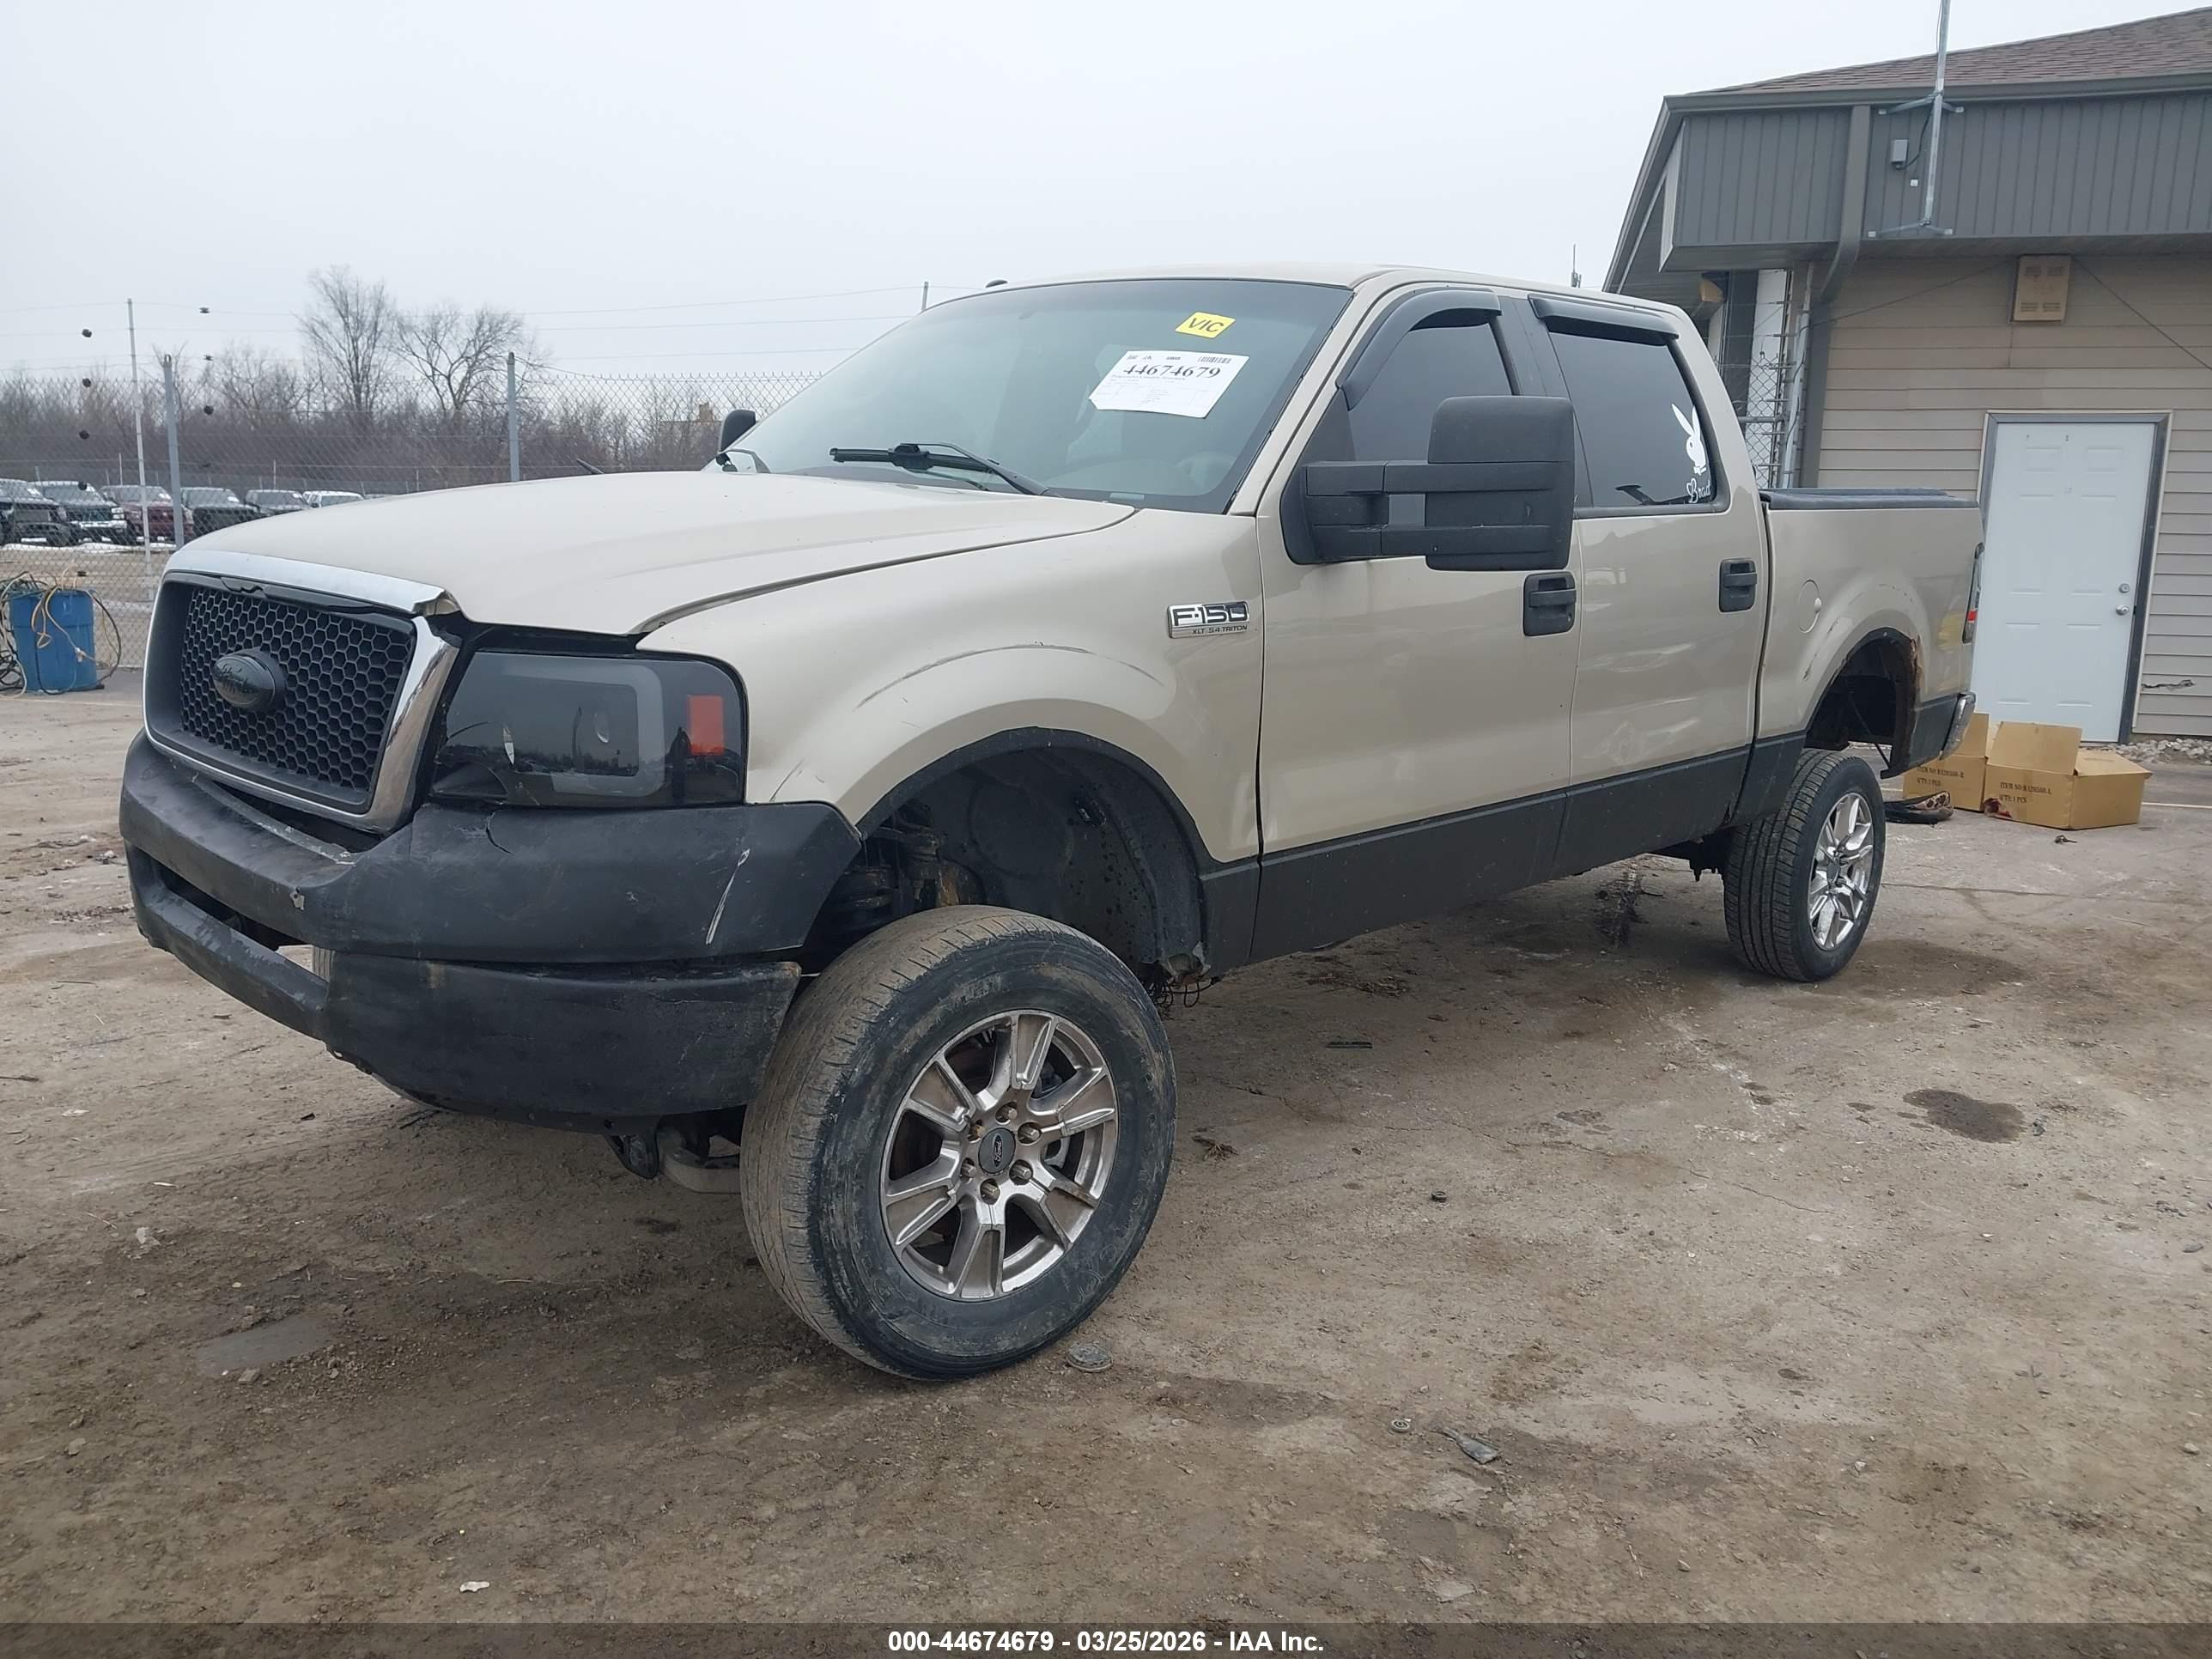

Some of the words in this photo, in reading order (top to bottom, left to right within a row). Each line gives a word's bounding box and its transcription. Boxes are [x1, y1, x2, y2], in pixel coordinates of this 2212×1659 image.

[1188, 317, 1224, 333] VIC
[1123, 364, 1221, 379] 44674679
[1170, 602, 1249, 626] F-150
